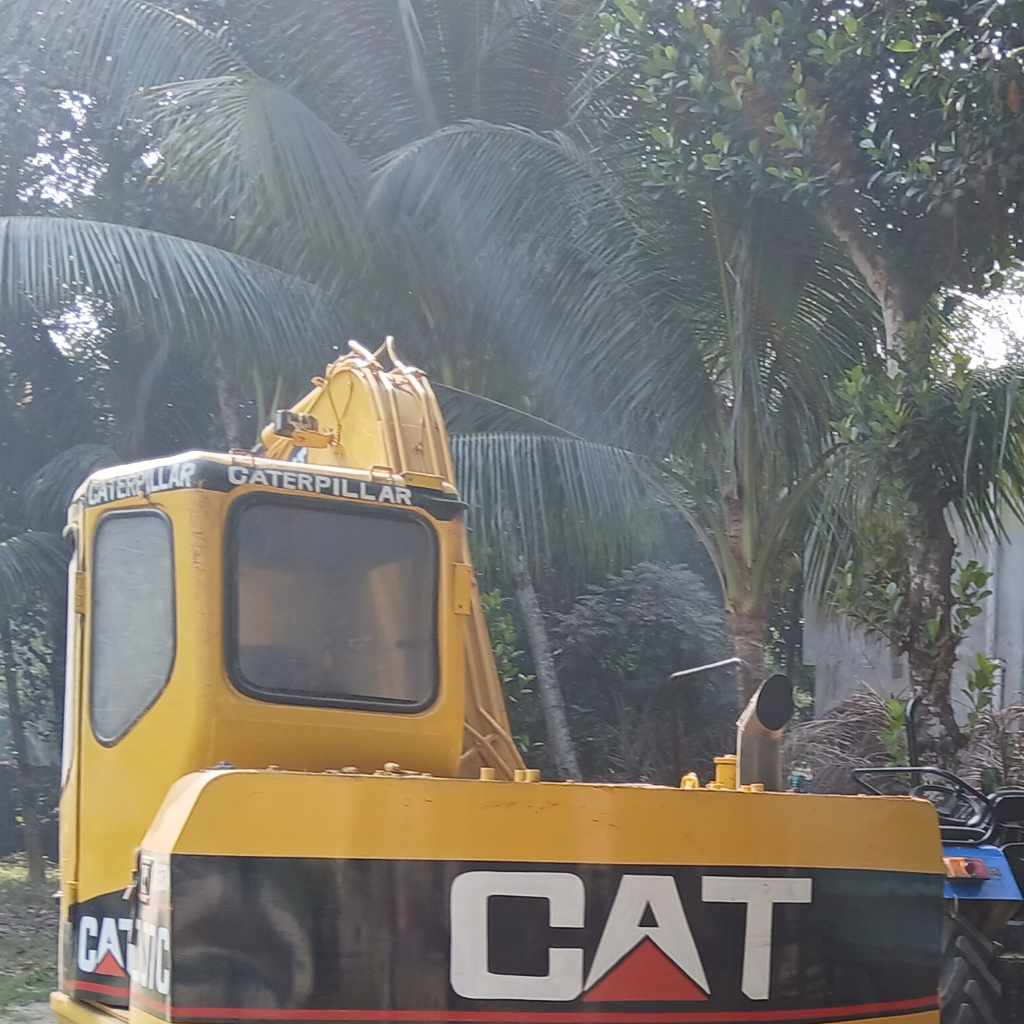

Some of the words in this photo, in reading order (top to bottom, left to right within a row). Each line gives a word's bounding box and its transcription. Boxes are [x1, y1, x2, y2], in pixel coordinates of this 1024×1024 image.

[87, 463, 196, 506] CATERPILLAR
[228, 466, 413, 506] CATERPILLAR
[78, 915, 139, 976] CAT
[450, 870, 812, 1002] CAT
